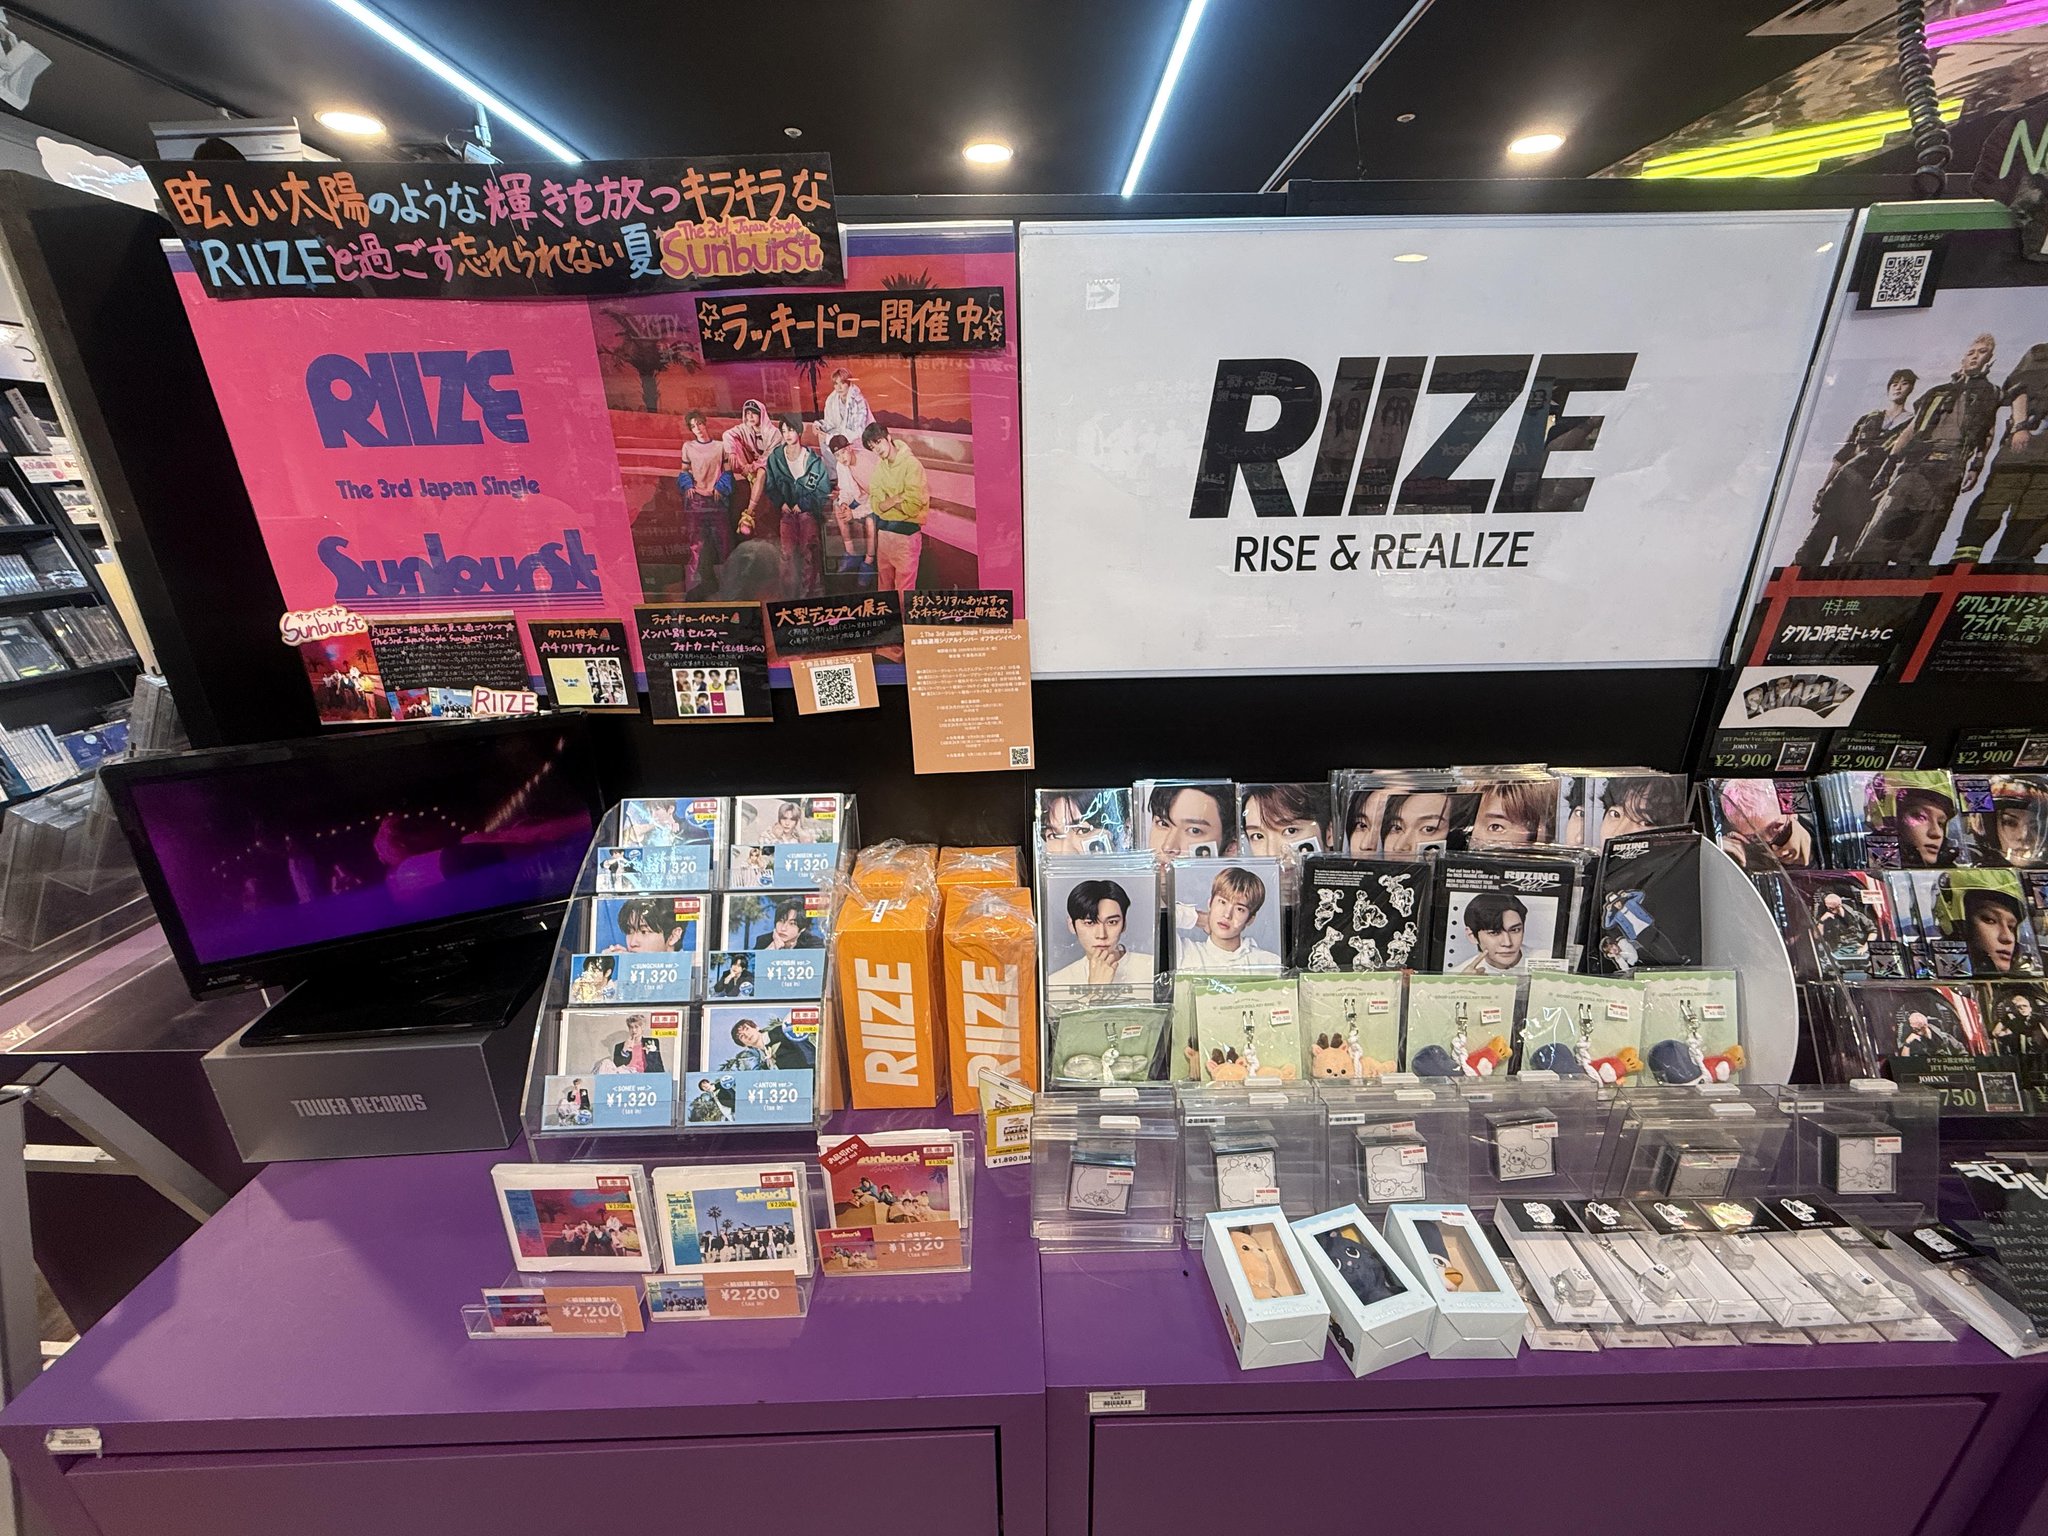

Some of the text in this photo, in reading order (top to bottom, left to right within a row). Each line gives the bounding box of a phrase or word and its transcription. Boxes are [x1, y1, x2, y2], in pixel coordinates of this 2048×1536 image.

[164, 168, 831, 230] 眩しい太陽のような輝きを放つキラキラな
[677, 222, 706, 240] The
[733, 218, 768, 236] Japan
[770, 215, 801, 234] Single
[206, 222, 662, 289] RIIZEと過ごす忘れられない夏
[662, 230, 821, 277] Sunburst
[721, 297, 983, 351] ラッキードロー開催中
[306, 349, 530, 448] RIIZE
[1189, 352, 1639, 519] RIIZE
[335, 474, 541, 502] The 3rd Japan Single
[1233, 530, 1536, 573] RISE & REALIZE
[317, 529, 603, 600] Sunburst
[775, 598, 892, 627] 大型ディスプレイ展示
[1821, 599, 1860, 616] 特典
[284, 616, 364, 642] Sunburst
[475, 689, 535, 713] RIIZE
[1714, 753, 1772, 769] ¥2,900
[1830, 753, 1884, 769] ¥2,900
[1956, 750, 2013, 766] ¥2,900
[785, 858, 829, 871] ¥1,320
[630, 969, 678, 984] ¥1,320
[767, 966, 815, 981] ¥1,320
[854, 958, 919, 1087] RIIZE
[961, 960, 1022, 1088] RIIZE
[1943, 1063, 1964, 1071] Poster
[1919, 1075, 1950, 1083] JOHNNY
[290, 1094, 427, 1117] TOWER RECORDS
[606, 1091, 657, 1107] ¥1,320
[748, 1088, 798, 1104] ¥1,320
[993, 1156, 1018, 1164] ¥1,890
[887, 1237, 944, 1253] ¥1,320
[720, 1287, 781, 1301] ¥2,200
[562, 1303, 623, 1318] ¥2,200
